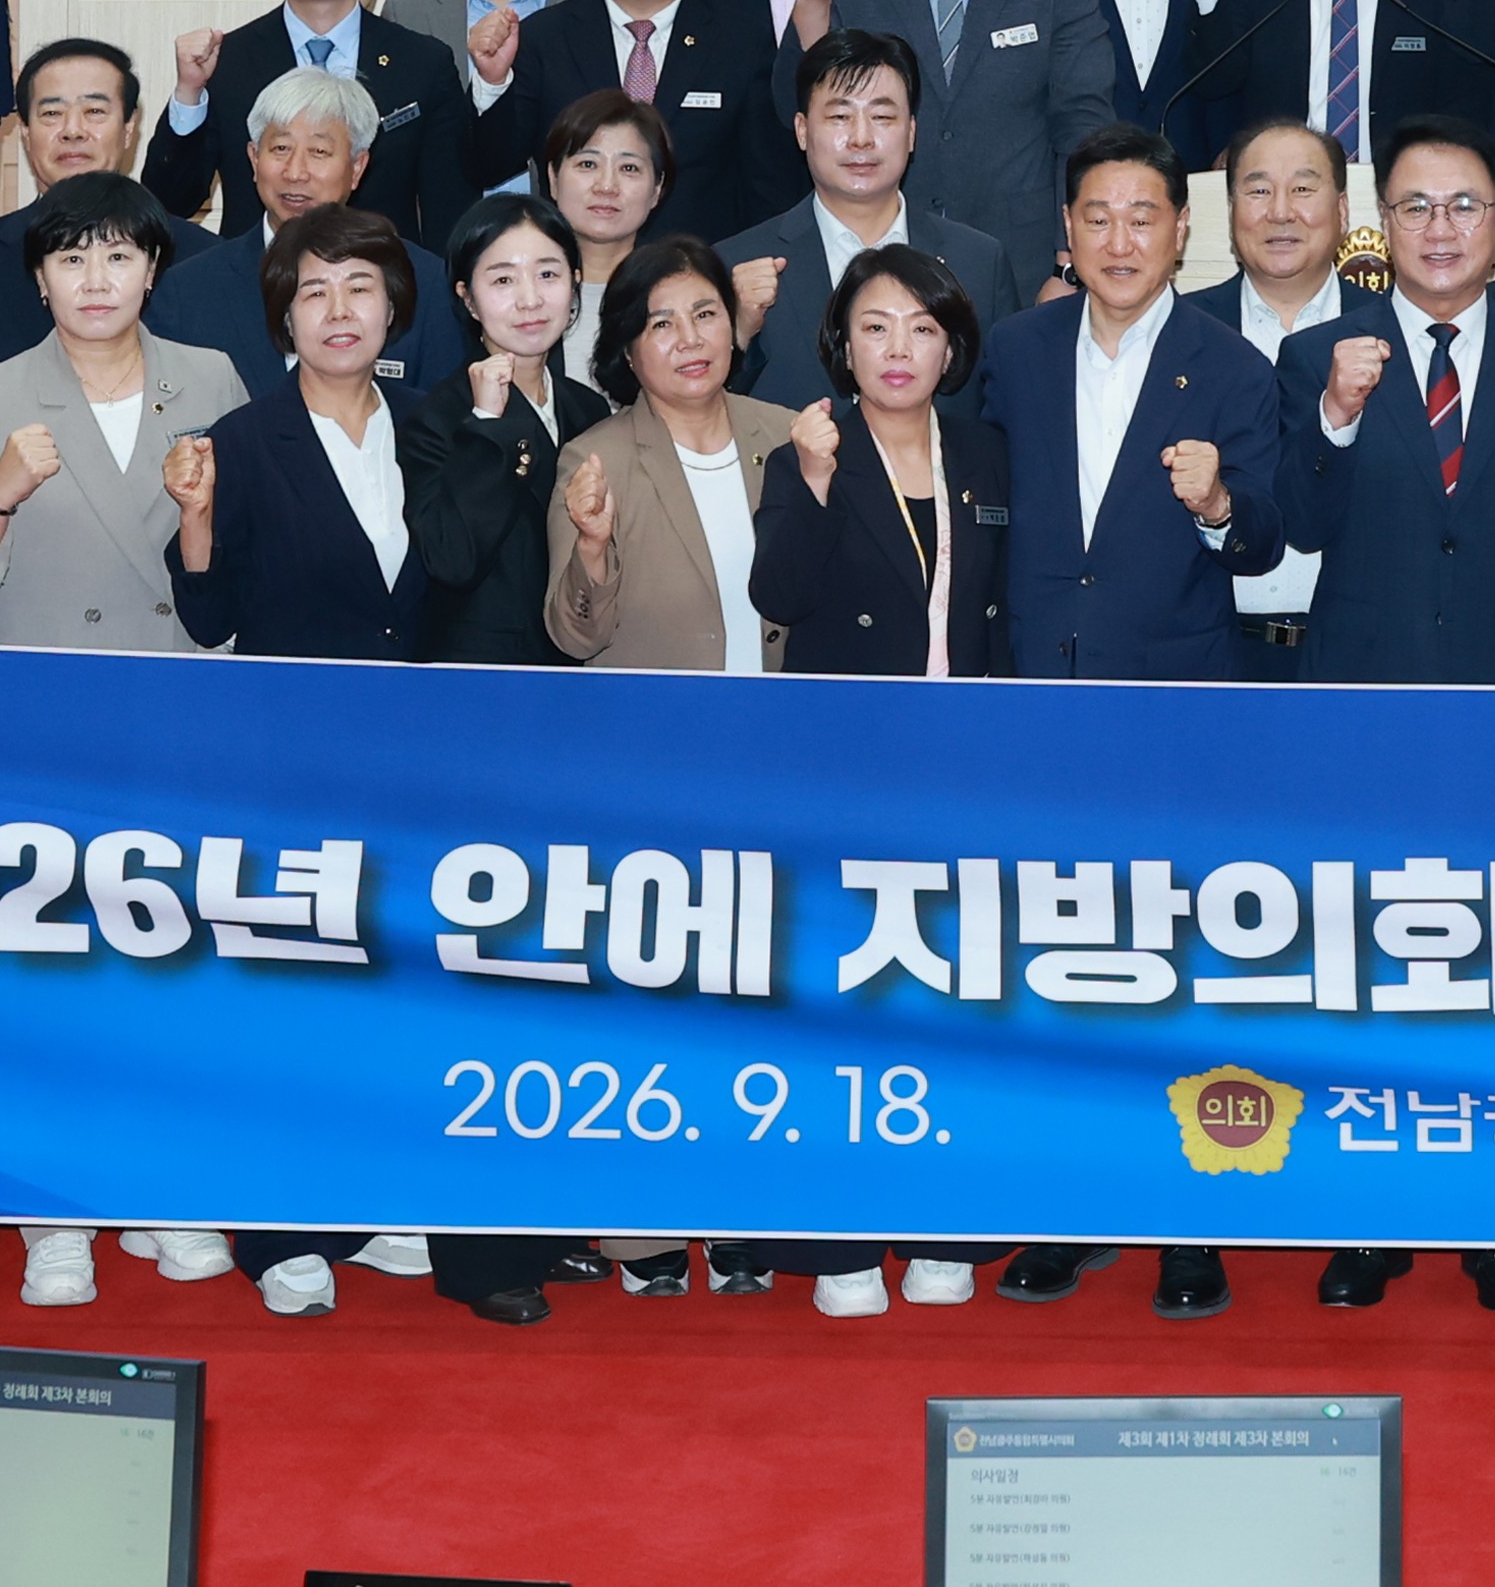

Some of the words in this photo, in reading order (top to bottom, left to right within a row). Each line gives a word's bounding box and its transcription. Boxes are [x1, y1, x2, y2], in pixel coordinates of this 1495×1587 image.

[431, 843, 774, 997] 안에
[444, 1060, 700, 1142] 2026.
[733, 1063, 800, 1143] 9.
[836, 1065, 951, 1145] 18.
[1200, 1094, 1271, 1131] 의회
[970, 1468, 1019, 1484] 의사일정
